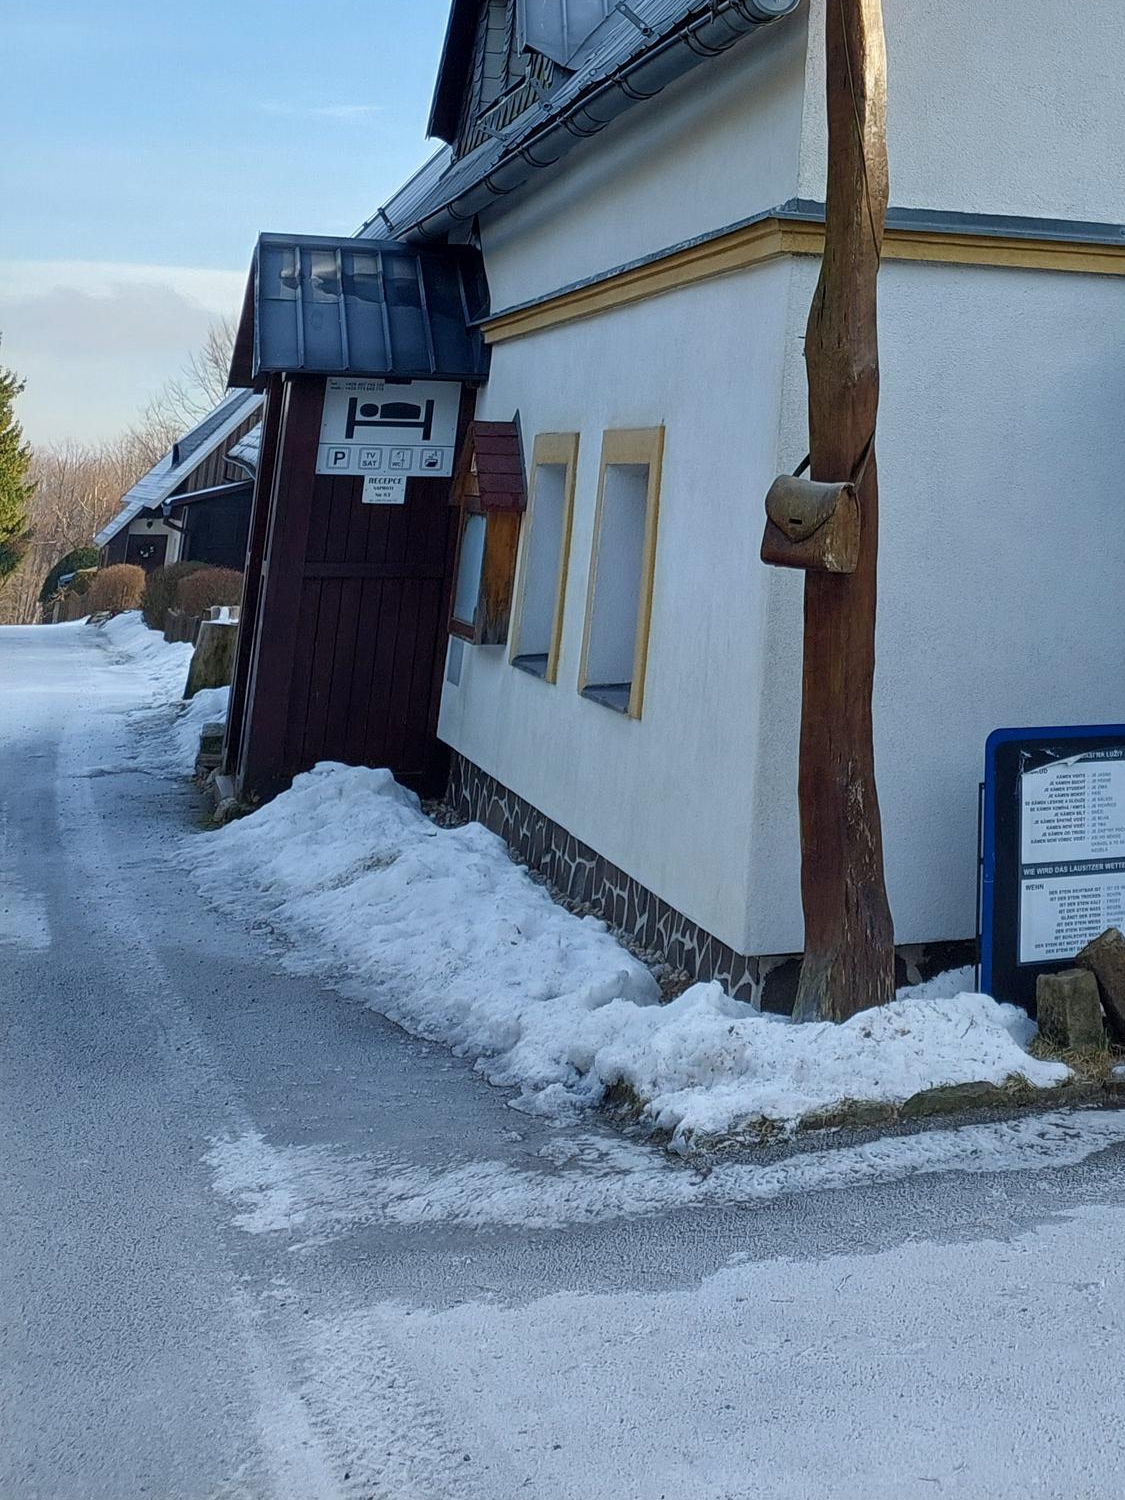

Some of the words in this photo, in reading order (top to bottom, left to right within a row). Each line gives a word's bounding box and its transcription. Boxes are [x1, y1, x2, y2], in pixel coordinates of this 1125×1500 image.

[334, 451, 346, 466] P
[368, 477, 402, 485] RECEPCE
[1023, 867, 1035, 875] WIE
[1036, 866, 1053, 875] WIRD
[1054, 864, 1068, 873] DAS
[1069, 862, 1104, 873] LAUSITZER
